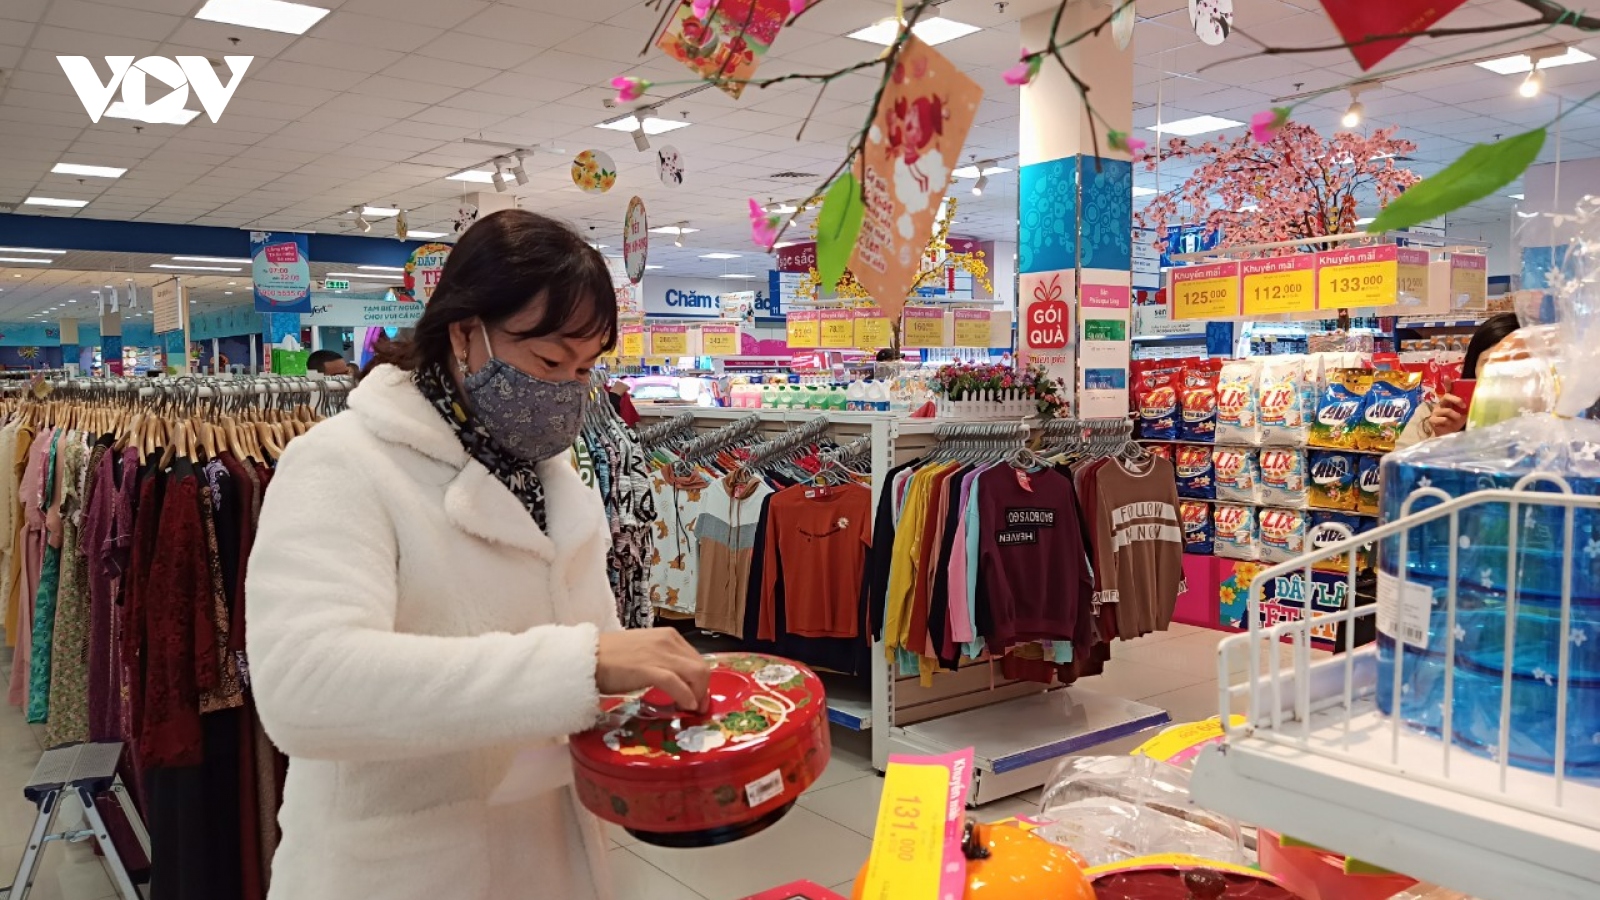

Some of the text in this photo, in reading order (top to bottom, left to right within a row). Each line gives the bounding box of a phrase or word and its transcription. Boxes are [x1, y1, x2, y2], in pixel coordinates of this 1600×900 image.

[1243, 260, 1294, 274] Khuyến mãi
[1319, 251, 1375, 266] Khuyến mãi
[421, 267, 443, 285] TẾ
[1174, 270, 1205, 280] Khuyến
[1330, 274, 1383, 293] 133.000
[665, 289, 711, 309] Chăm
[754, 291, 770, 309] ắc
[1183, 288, 1226, 305] 125.000
[1255, 283, 1302, 301] 112.000
[1033, 304, 1062, 323] GÓI
[1030, 324, 1065, 344] QUÀ
[1120, 502, 1164, 522] FOLLOW
[999, 532, 1034, 543] HEAVEN
[890, 795, 922, 862] 131.000
